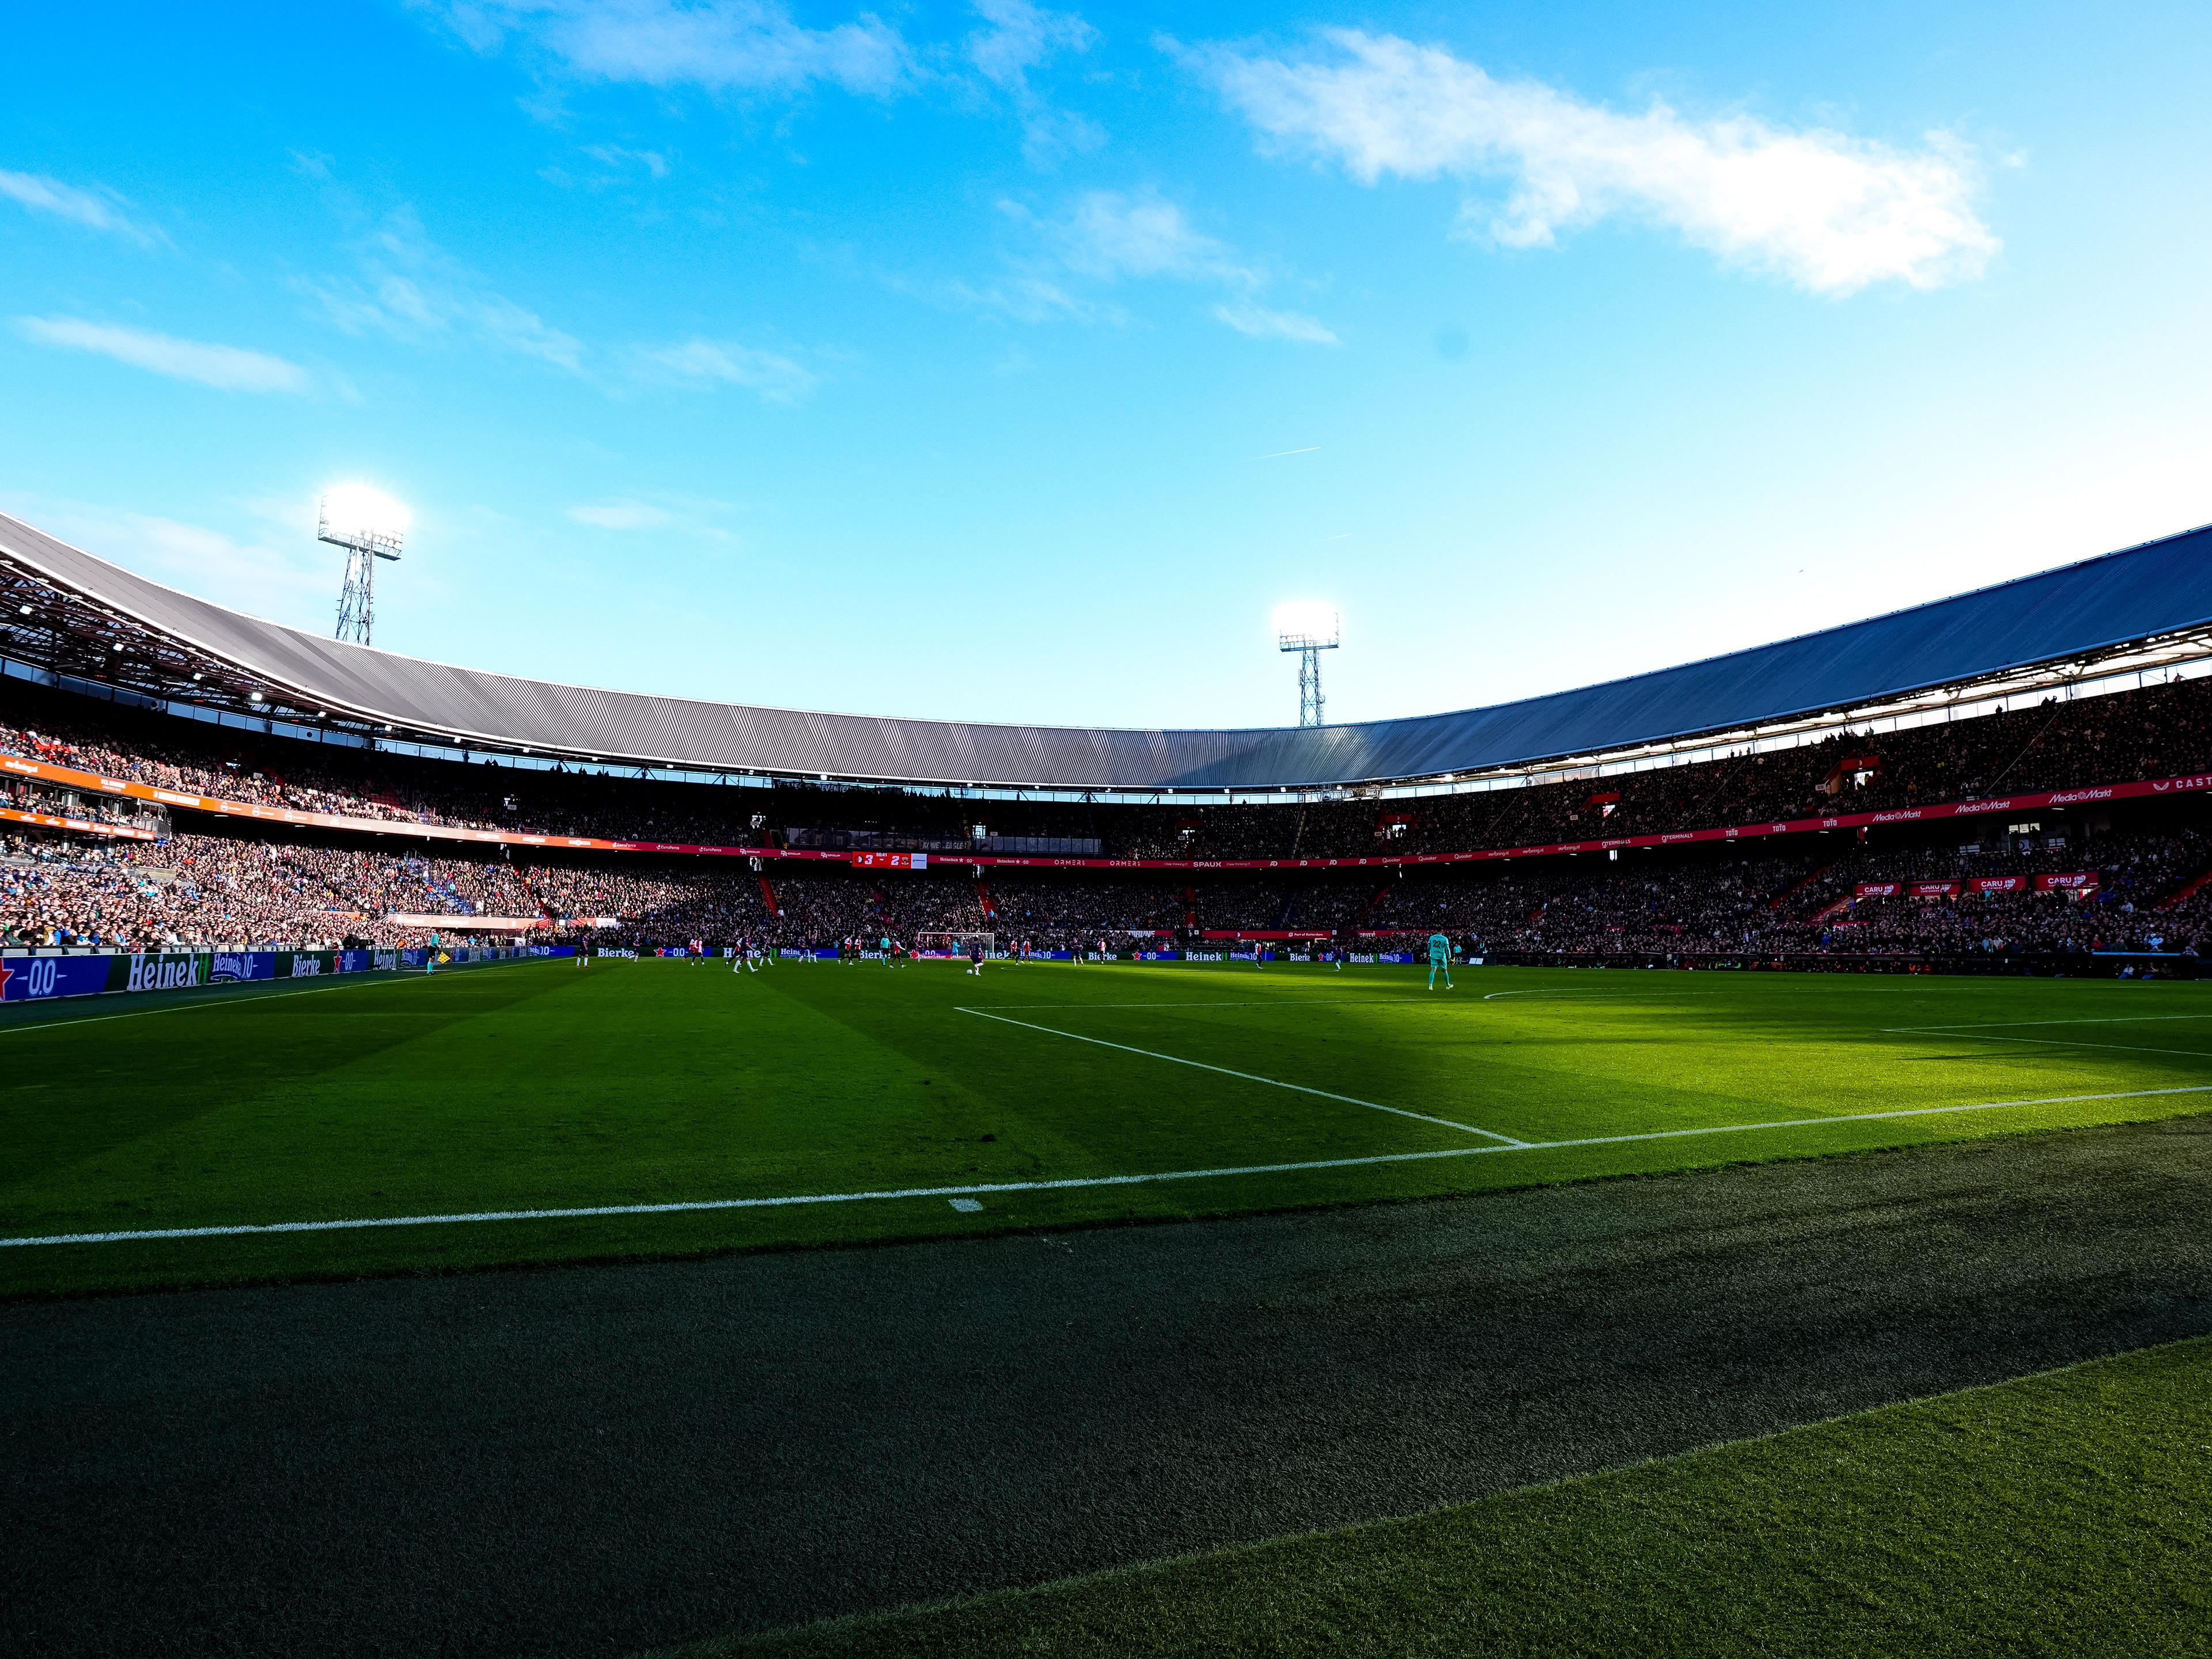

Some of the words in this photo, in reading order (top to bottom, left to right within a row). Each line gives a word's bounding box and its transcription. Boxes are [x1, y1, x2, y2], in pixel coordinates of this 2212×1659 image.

[2176, 777, 2212, 789] CAST
[2049, 794, 2077, 804] Media
[2085, 789, 2112, 799] Markt
[1955, 805, 1980, 813] Media
[1987, 801, 2010, 810] Markt
[1872, 813, 1894, 822] Media
[1900, 810, 1922, 819] Markt
[1772, 824, 1786, 832] TOTO
[1823, 819, 1837, 827] TOTO
[1726, 828, 1738, 836] TOTO
[1661, 833, 1693, 843] QTERMINALS
[865, 855, 873, 865] 3
[891, 855, 899, 865] 2
[597, 948, 635, 957] Bierke
[673, 948, 684, 957] 0.0
[1088, 952, 1117, 960] Bierke
[1147, 952, 1156, 960] 0.0
[1185, 952, 1222, 961] Heinek
[1290, 953, 1310, 961] Bierke
[1350, 953, 1374, 963] Heinek
[292, 954, 320, 977] Bierke
[126, 954, 199, 990] Heinek
[29, 960, 56, 995] 0.0
